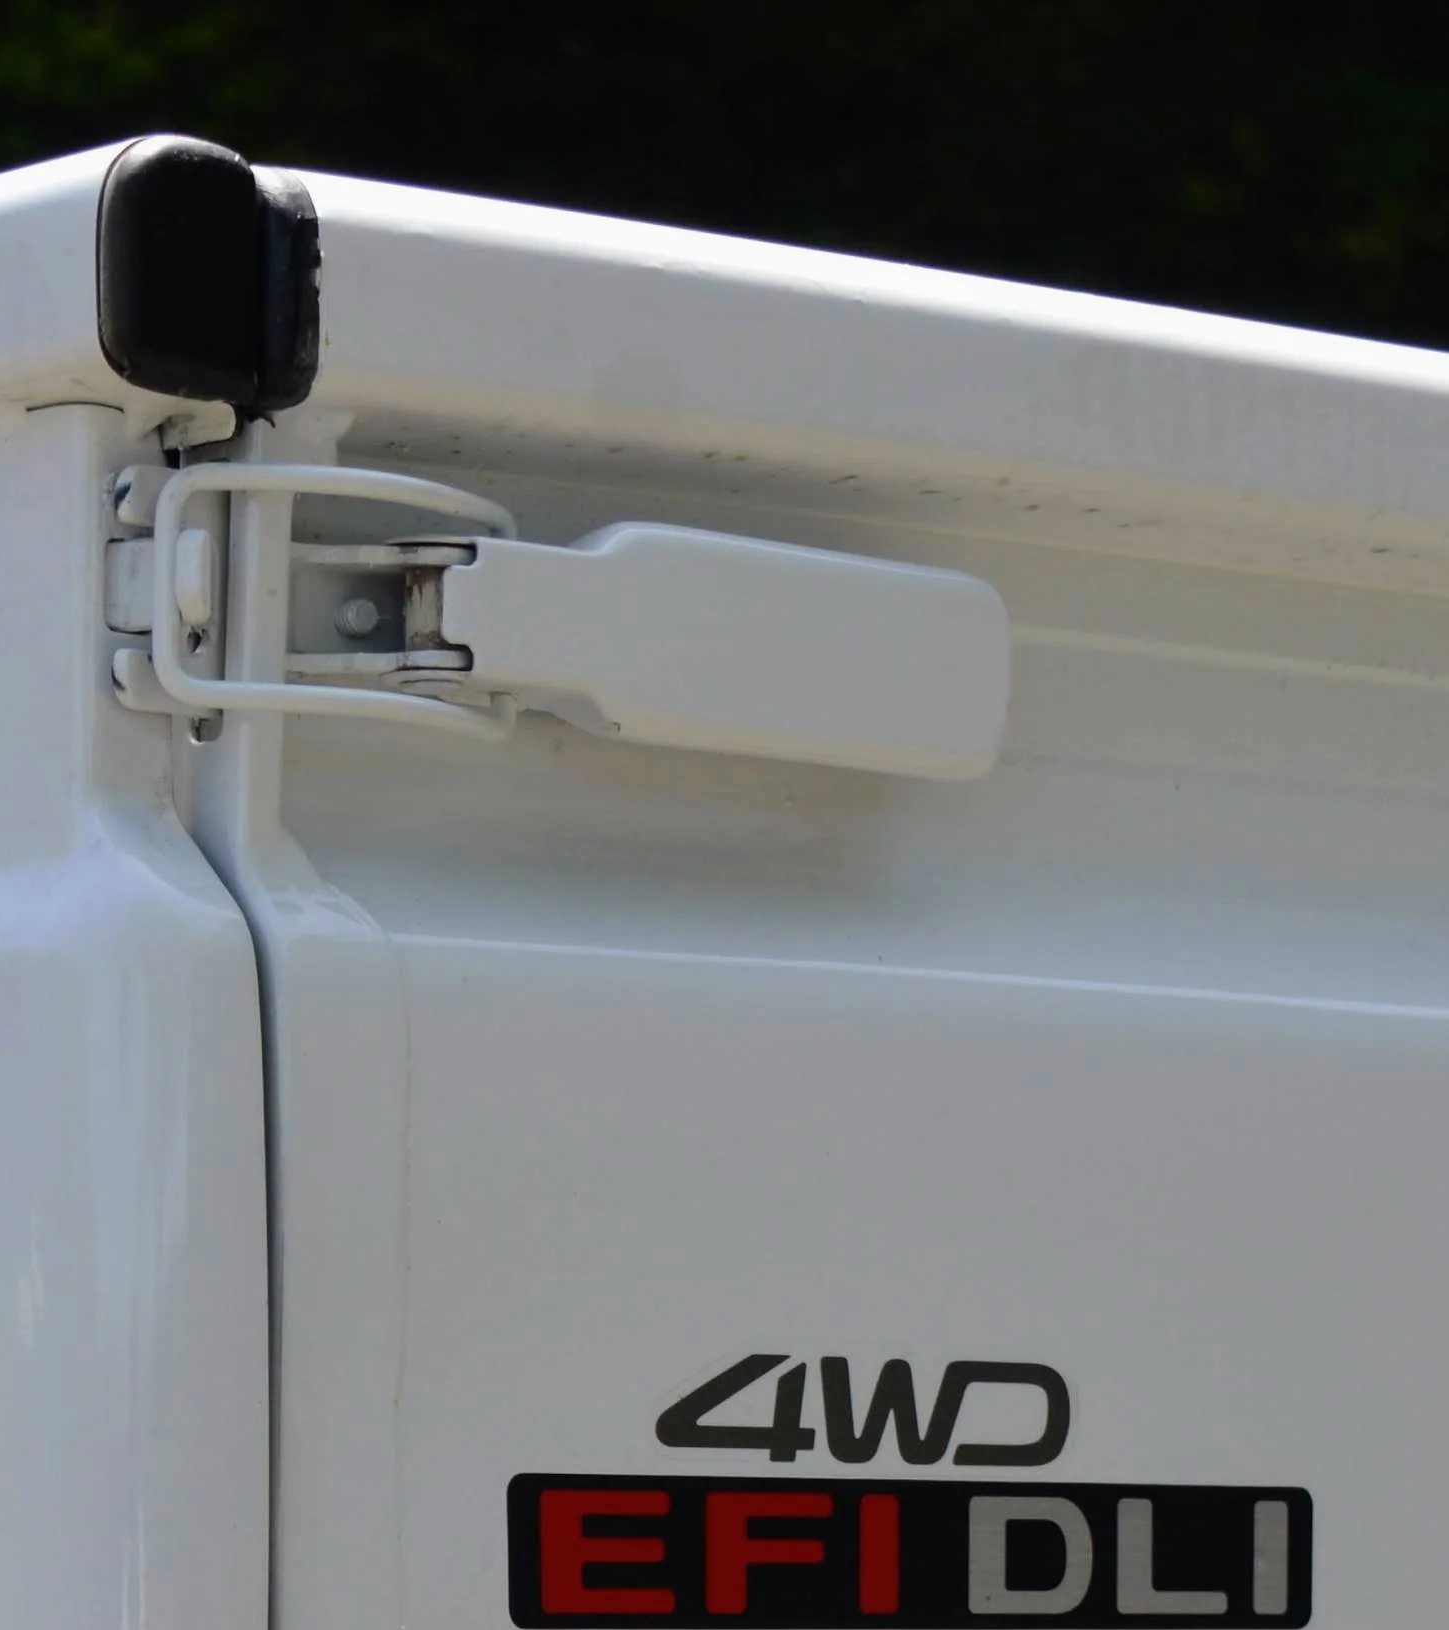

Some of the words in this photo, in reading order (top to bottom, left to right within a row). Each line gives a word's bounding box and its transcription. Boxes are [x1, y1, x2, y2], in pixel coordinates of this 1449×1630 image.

[656, 1354, 1070, 1466] 4WD
[540, 1489, 899, 1614] EFI
[968, 1495, 1289, 1615] DLI
